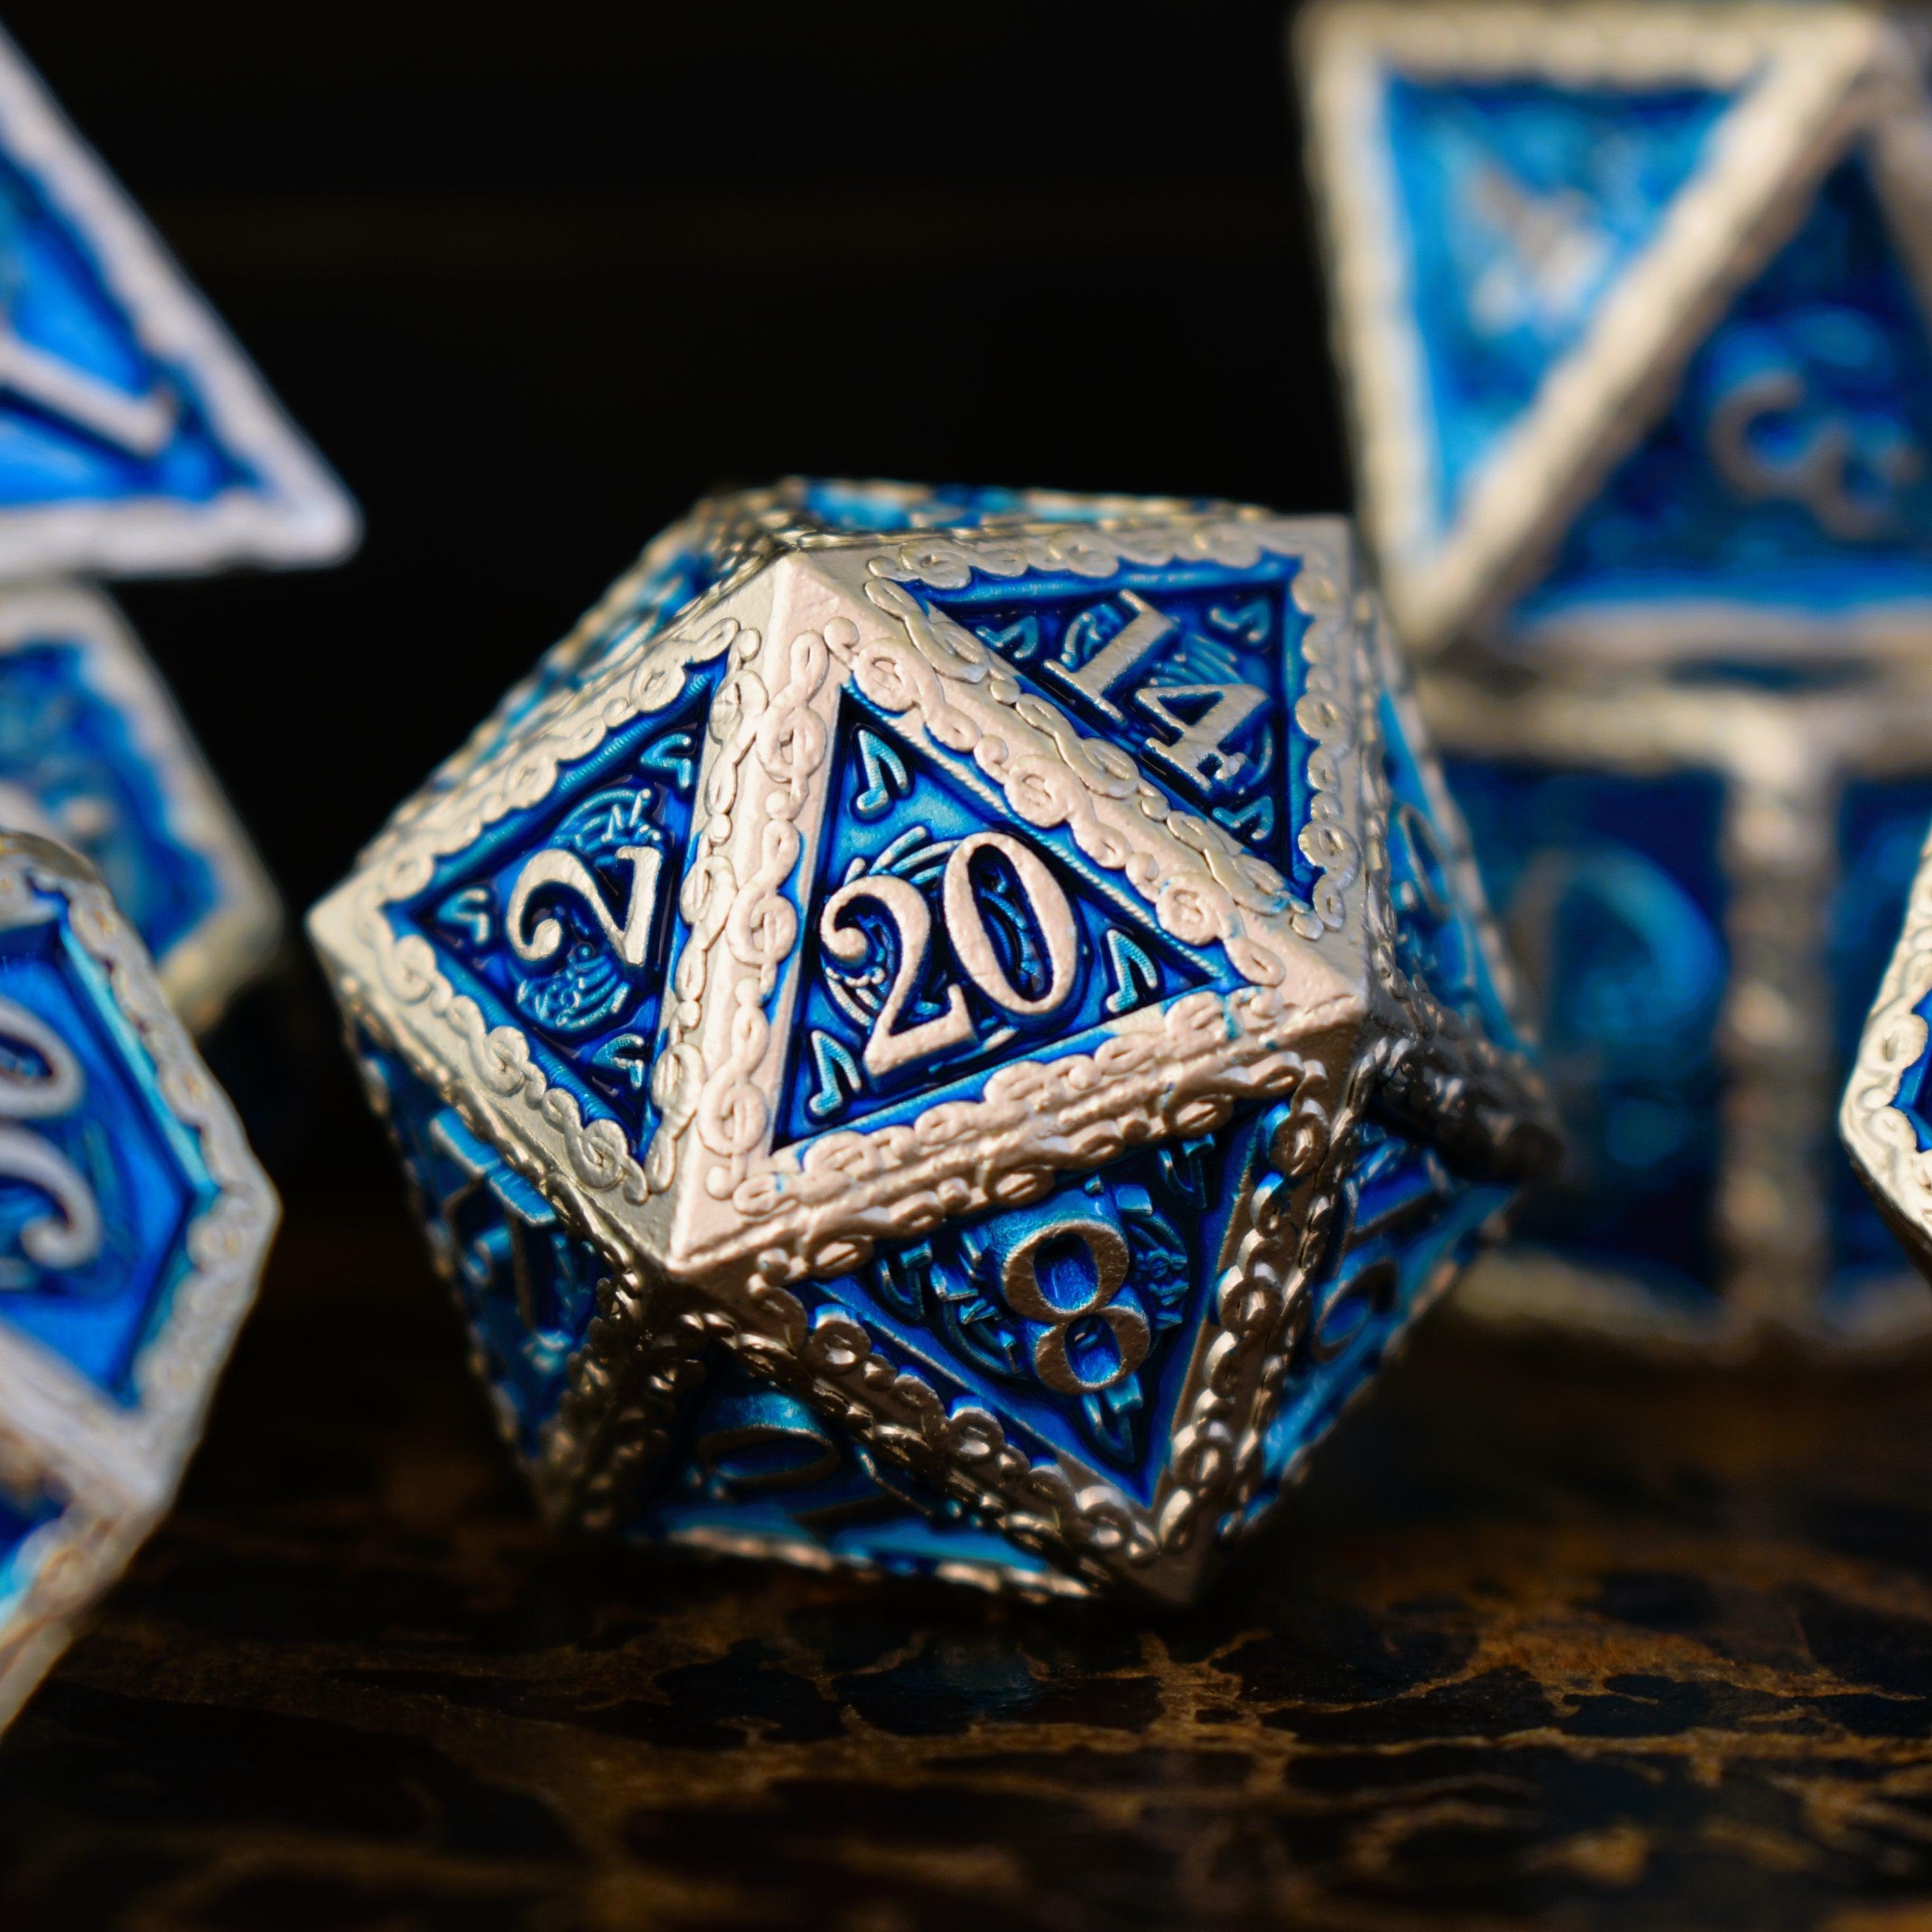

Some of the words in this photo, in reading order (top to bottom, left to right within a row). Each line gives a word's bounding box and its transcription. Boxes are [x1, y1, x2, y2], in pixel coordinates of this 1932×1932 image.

[1043, 589, 1271, 793] 14
[507, 844, 663, 967] 2
[819, 830, 1078, 1078] 20
[1003, 1217, 1151, 1396] 8
